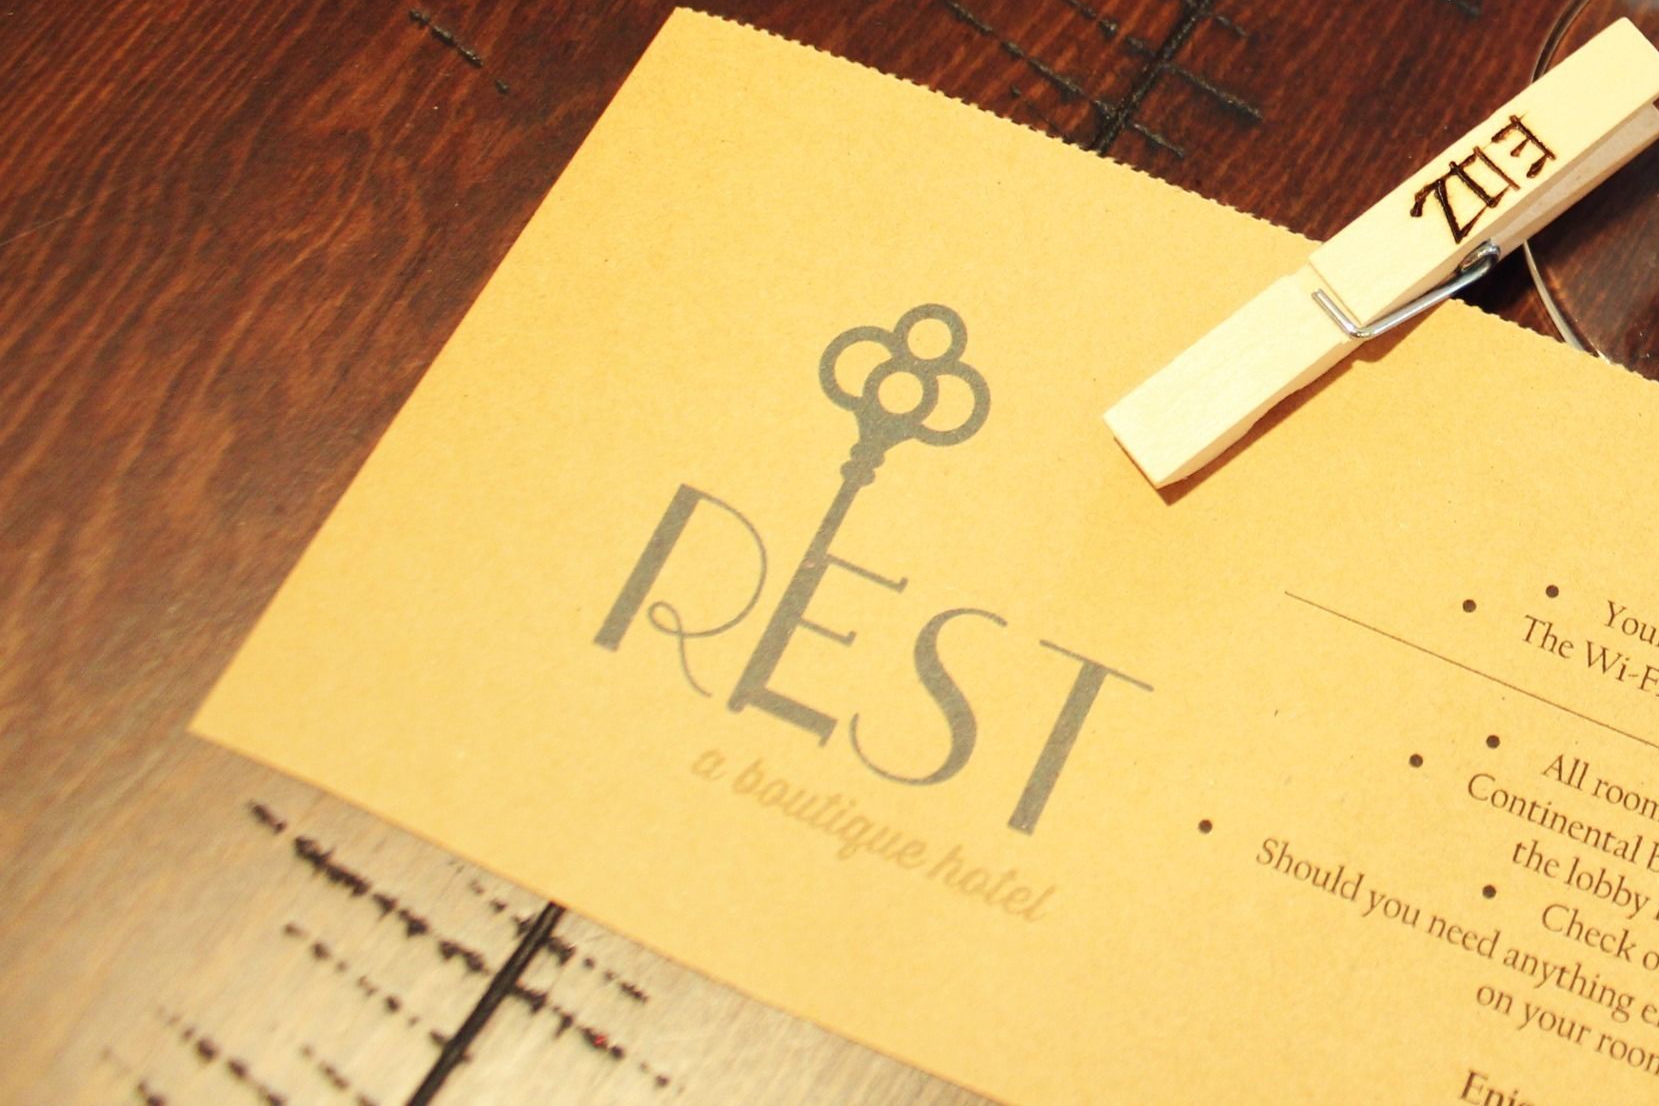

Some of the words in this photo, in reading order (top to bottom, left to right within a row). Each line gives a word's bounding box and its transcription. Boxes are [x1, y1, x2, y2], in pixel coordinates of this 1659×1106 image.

[592, 482, 1154, 836] REST
[1521, 614, 1574, 660] The
[1541, 753, 1590, 790] All
[690, 747, 726, 784] a
[732, 754, 928, 870] boutique
[926, 839, 1056, 924] hotel
[1467, 772, 1643, 863] Continental
[1511, 838, 1561, 878] the
[1564, 855, 1651, 920] lobby
[1255, 837, 1365, 902] Should
[1361, 888, 1421, 928] you
[1426, 913, 1501, 960] need
[1502, 946, 1635, 1024] anything
[1541, 902, 1637, 963] Check
[1475, 983, 1514, 1015] on
[1516, 1001, 1592, 1048] your
